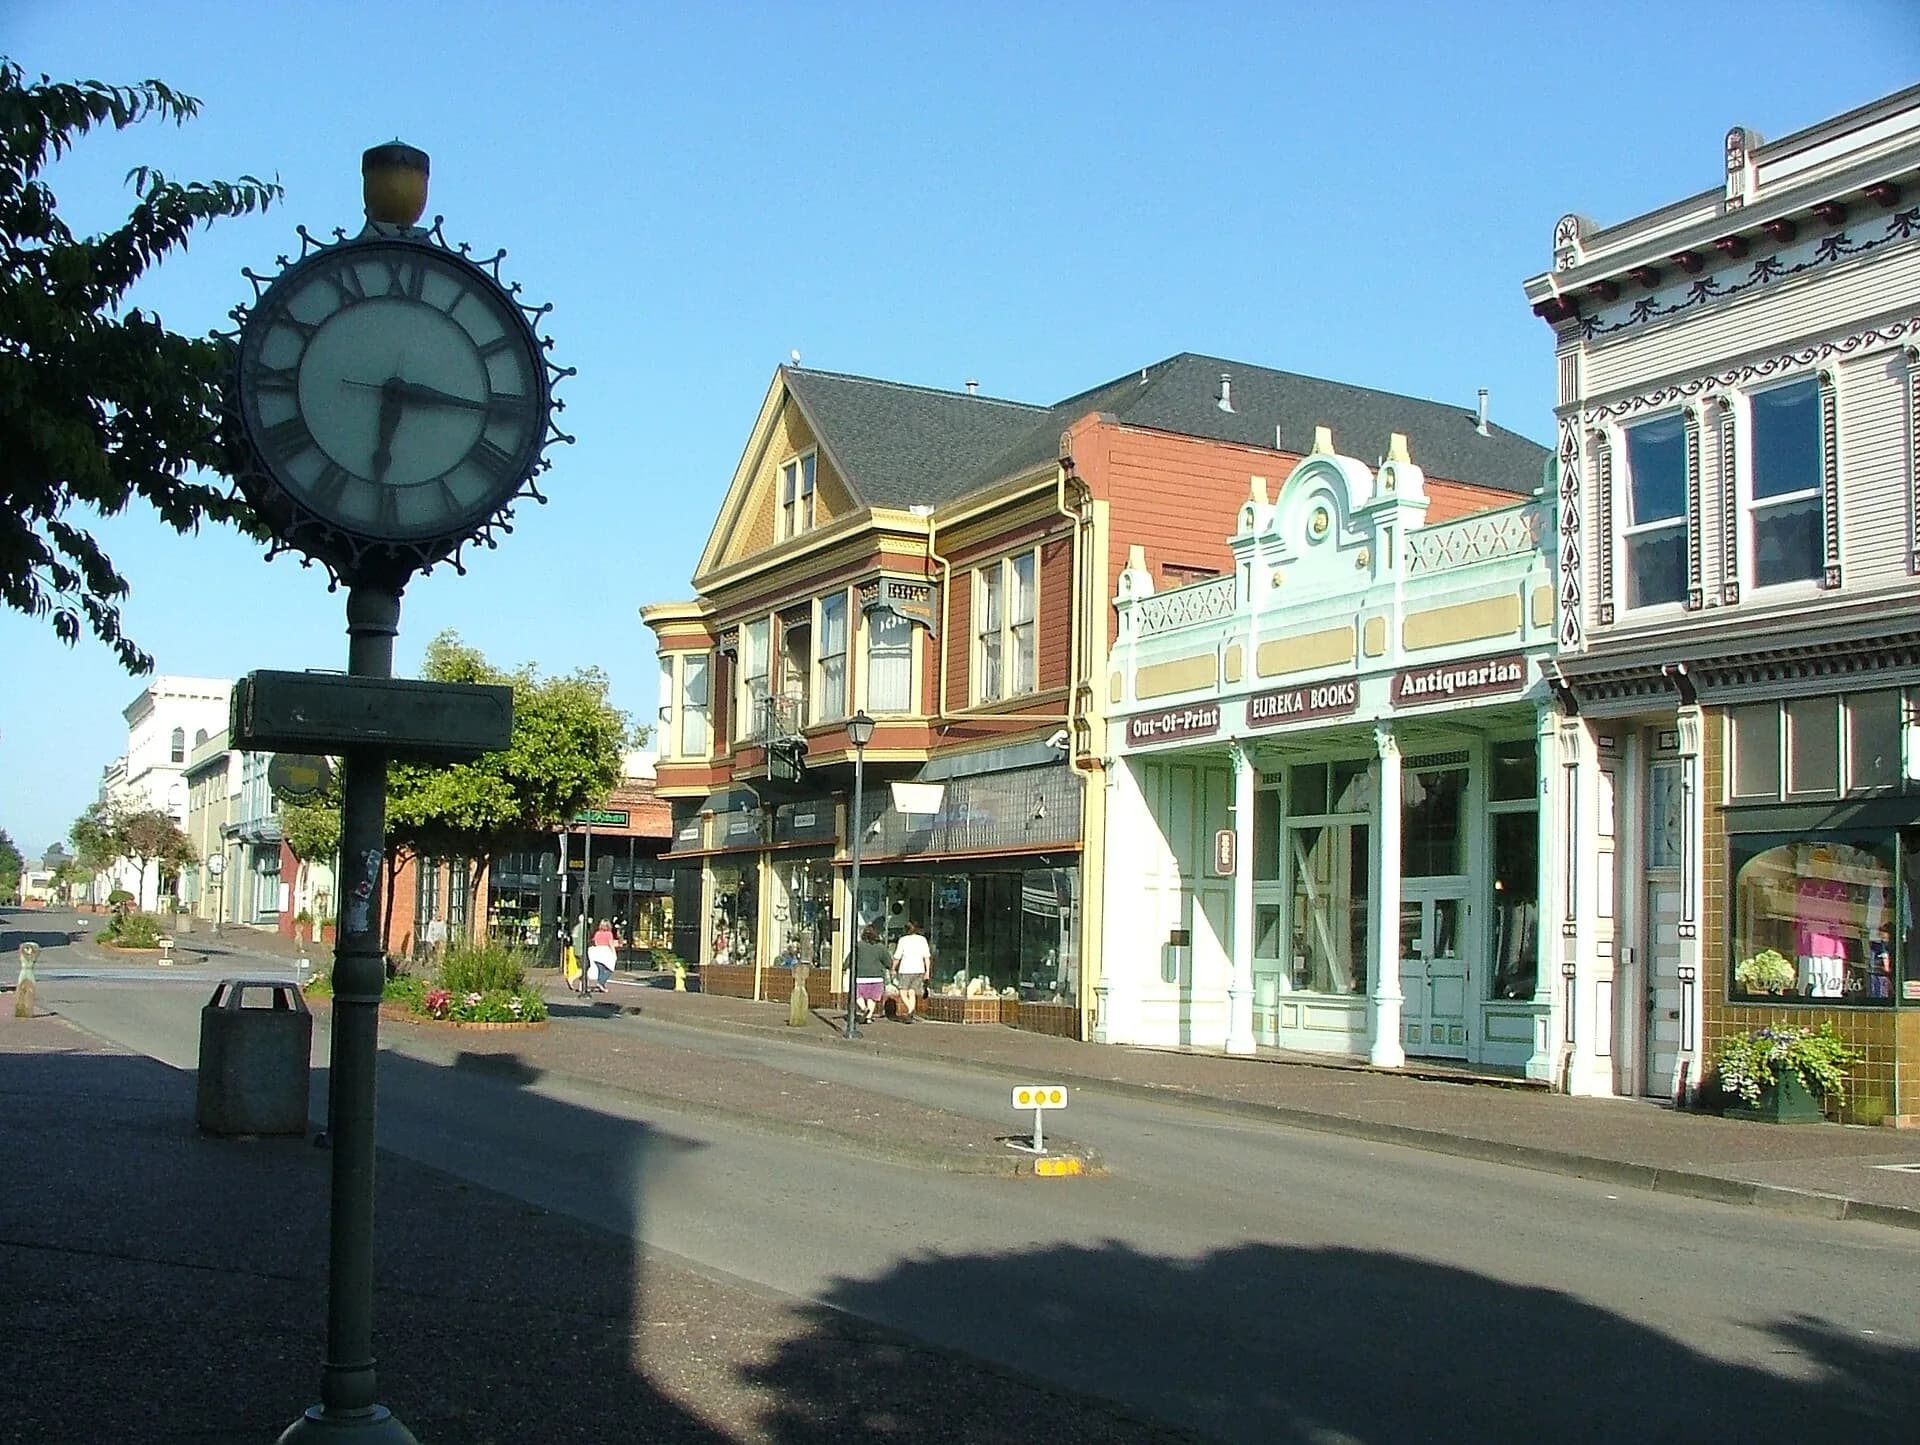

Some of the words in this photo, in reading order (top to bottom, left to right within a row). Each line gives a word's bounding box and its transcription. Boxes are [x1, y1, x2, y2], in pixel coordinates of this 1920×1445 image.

[1400, 661, 1522, 696] Antiquarian
[1252, 692, 1304, 719] EUREKA
[1309, 683, 1356, 709] BOOKS
[1133, 708, 1218, 738] Out-Of-Print
